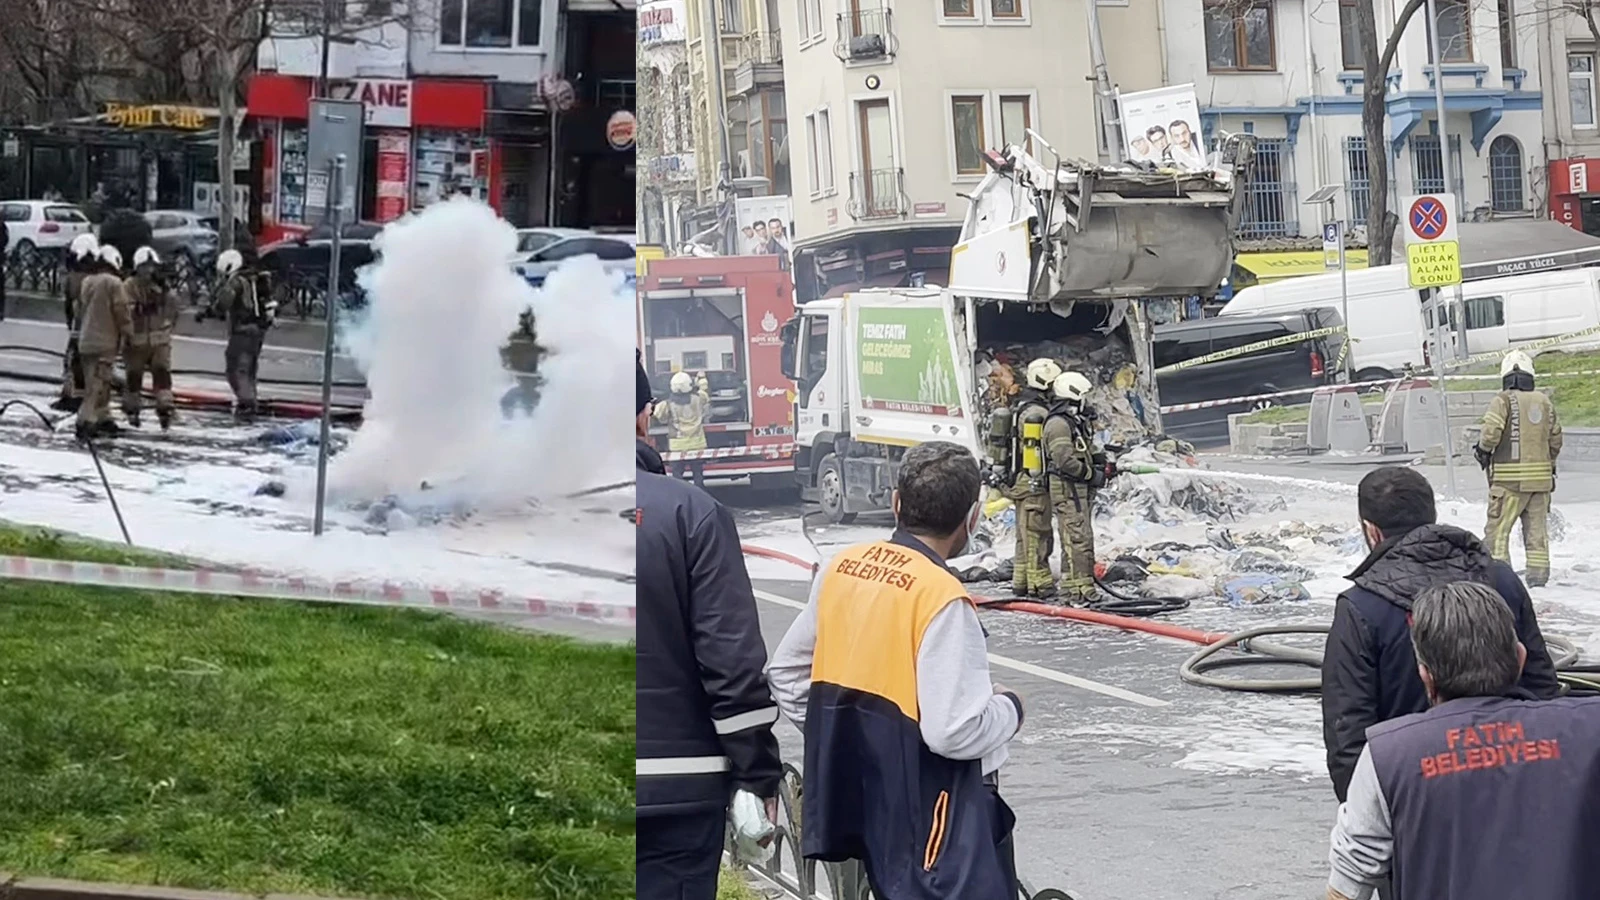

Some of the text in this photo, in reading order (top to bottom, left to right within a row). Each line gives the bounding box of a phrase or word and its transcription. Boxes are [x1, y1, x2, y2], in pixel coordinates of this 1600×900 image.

[1412, 254, 1455, 265] DURAK
[1419, 274, 1453, 284] SONU
[861, 545, 913, 569] FATİH
[835, 558, 918, 592] BELEDİYESİ
[1446, 722, 1524, 749] FATİH
[1421, 739, 1560, 778] BELEDİYESİ
